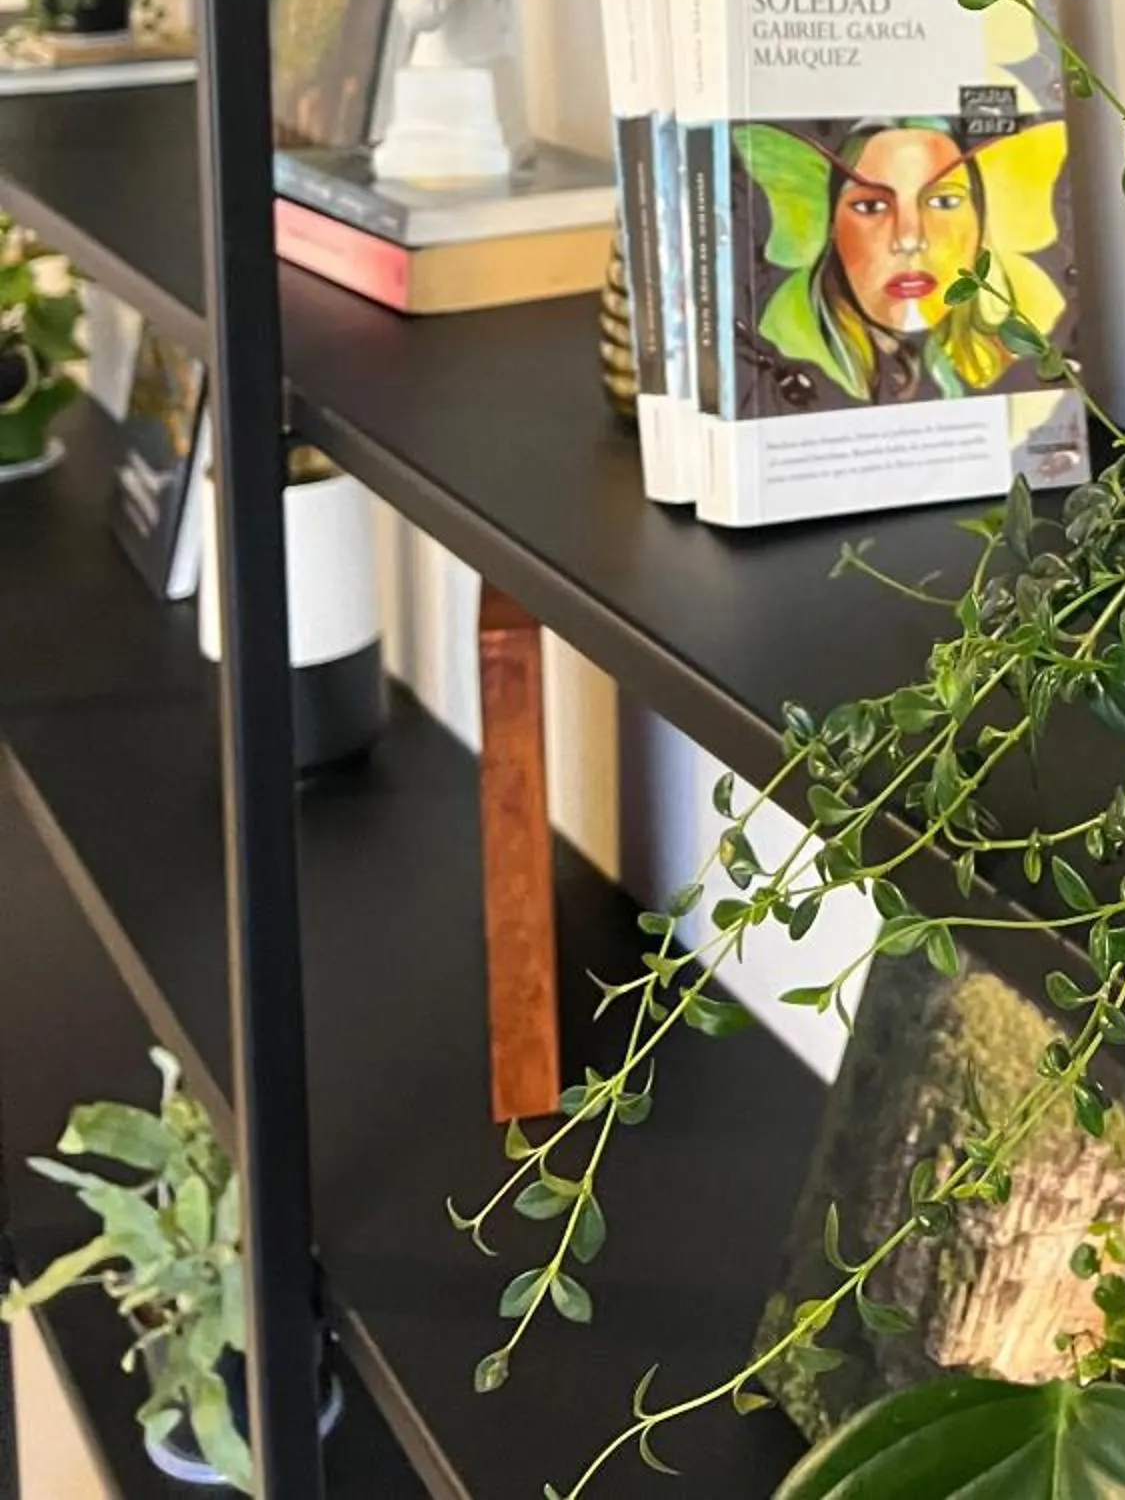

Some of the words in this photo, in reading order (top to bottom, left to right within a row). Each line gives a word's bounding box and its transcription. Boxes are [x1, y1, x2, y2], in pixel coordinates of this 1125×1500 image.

[752, 20, 842, 40] GABRIEL
[846, 17, 927, 41] GARCÍA
[753, 43, 862, 70] MÁRQUEZ
